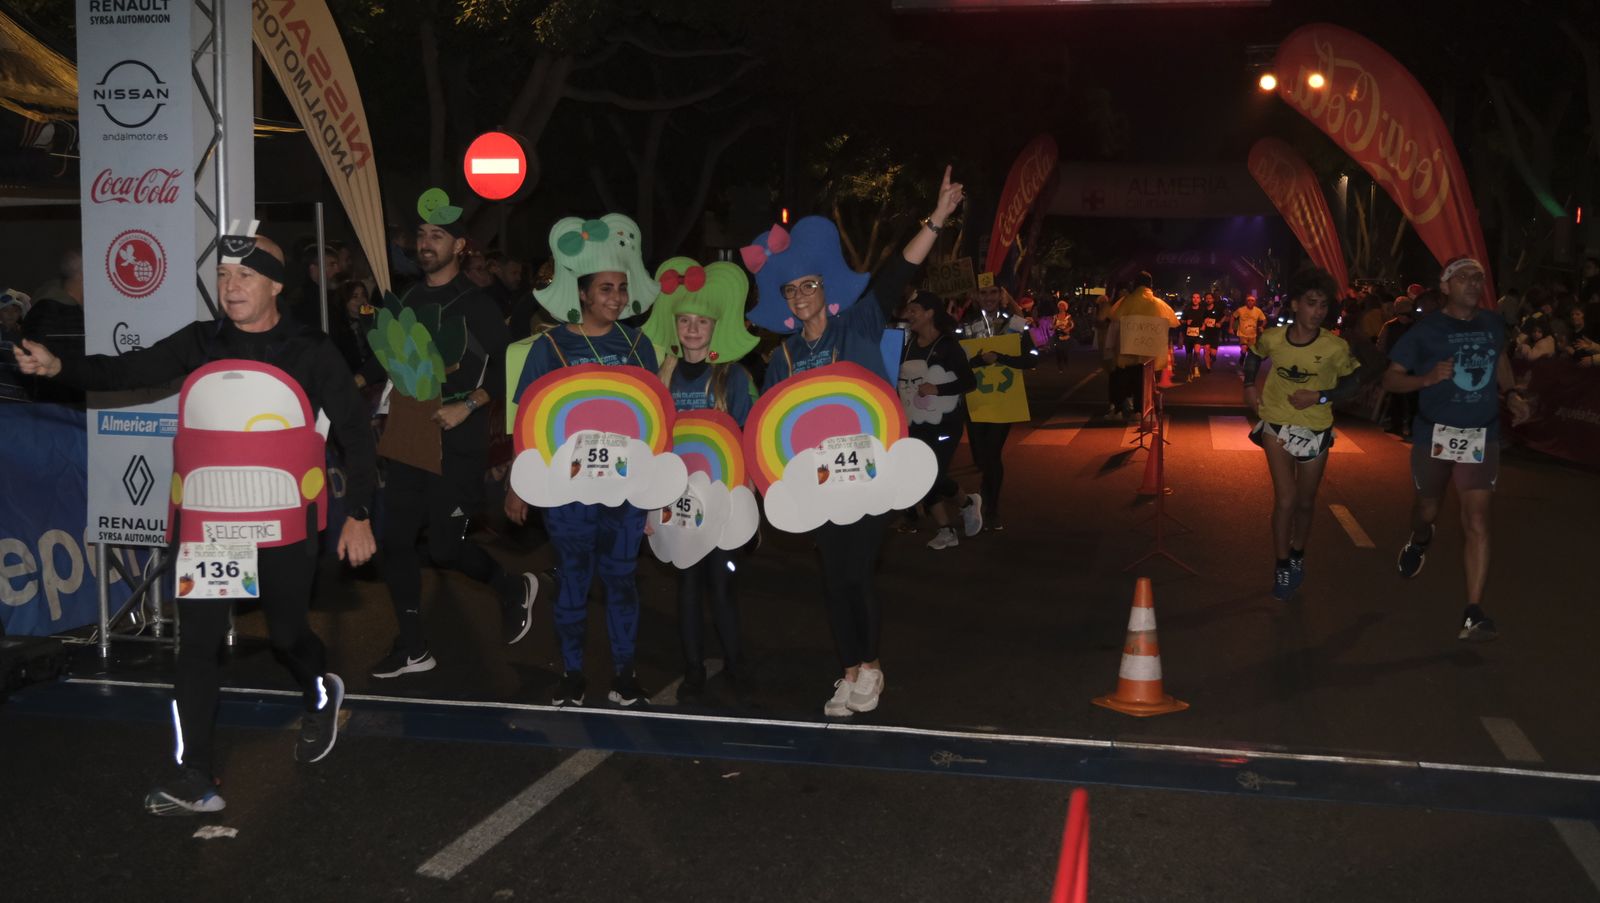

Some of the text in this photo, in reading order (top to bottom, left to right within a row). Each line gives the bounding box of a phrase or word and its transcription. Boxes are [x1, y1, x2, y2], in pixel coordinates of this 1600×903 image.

[89, 0, 168, 12] RENAULT
[90, 14, 170, 25] SYRSA AUTOMOCION
[93, 88, 169, 100] NISSAN
[102, 133, 168, 141] andalmotor.es
[91, 168, 184, 204] Coca-Cola
[101, 416, 158, 433] Almericar
[1289, 433, 1311, 448] 777
[1449, 438, 1468, 450] 62
[588, 448, 609, 463] 58
[834, 451, 859, 466] 44
[676, 497, 691, 512] 45
[99, 516, 167, 531] RENAUL
[99, 531, 168, 543] SYRSA AUTOMOCI
[196, 561, 239, 578] 136
